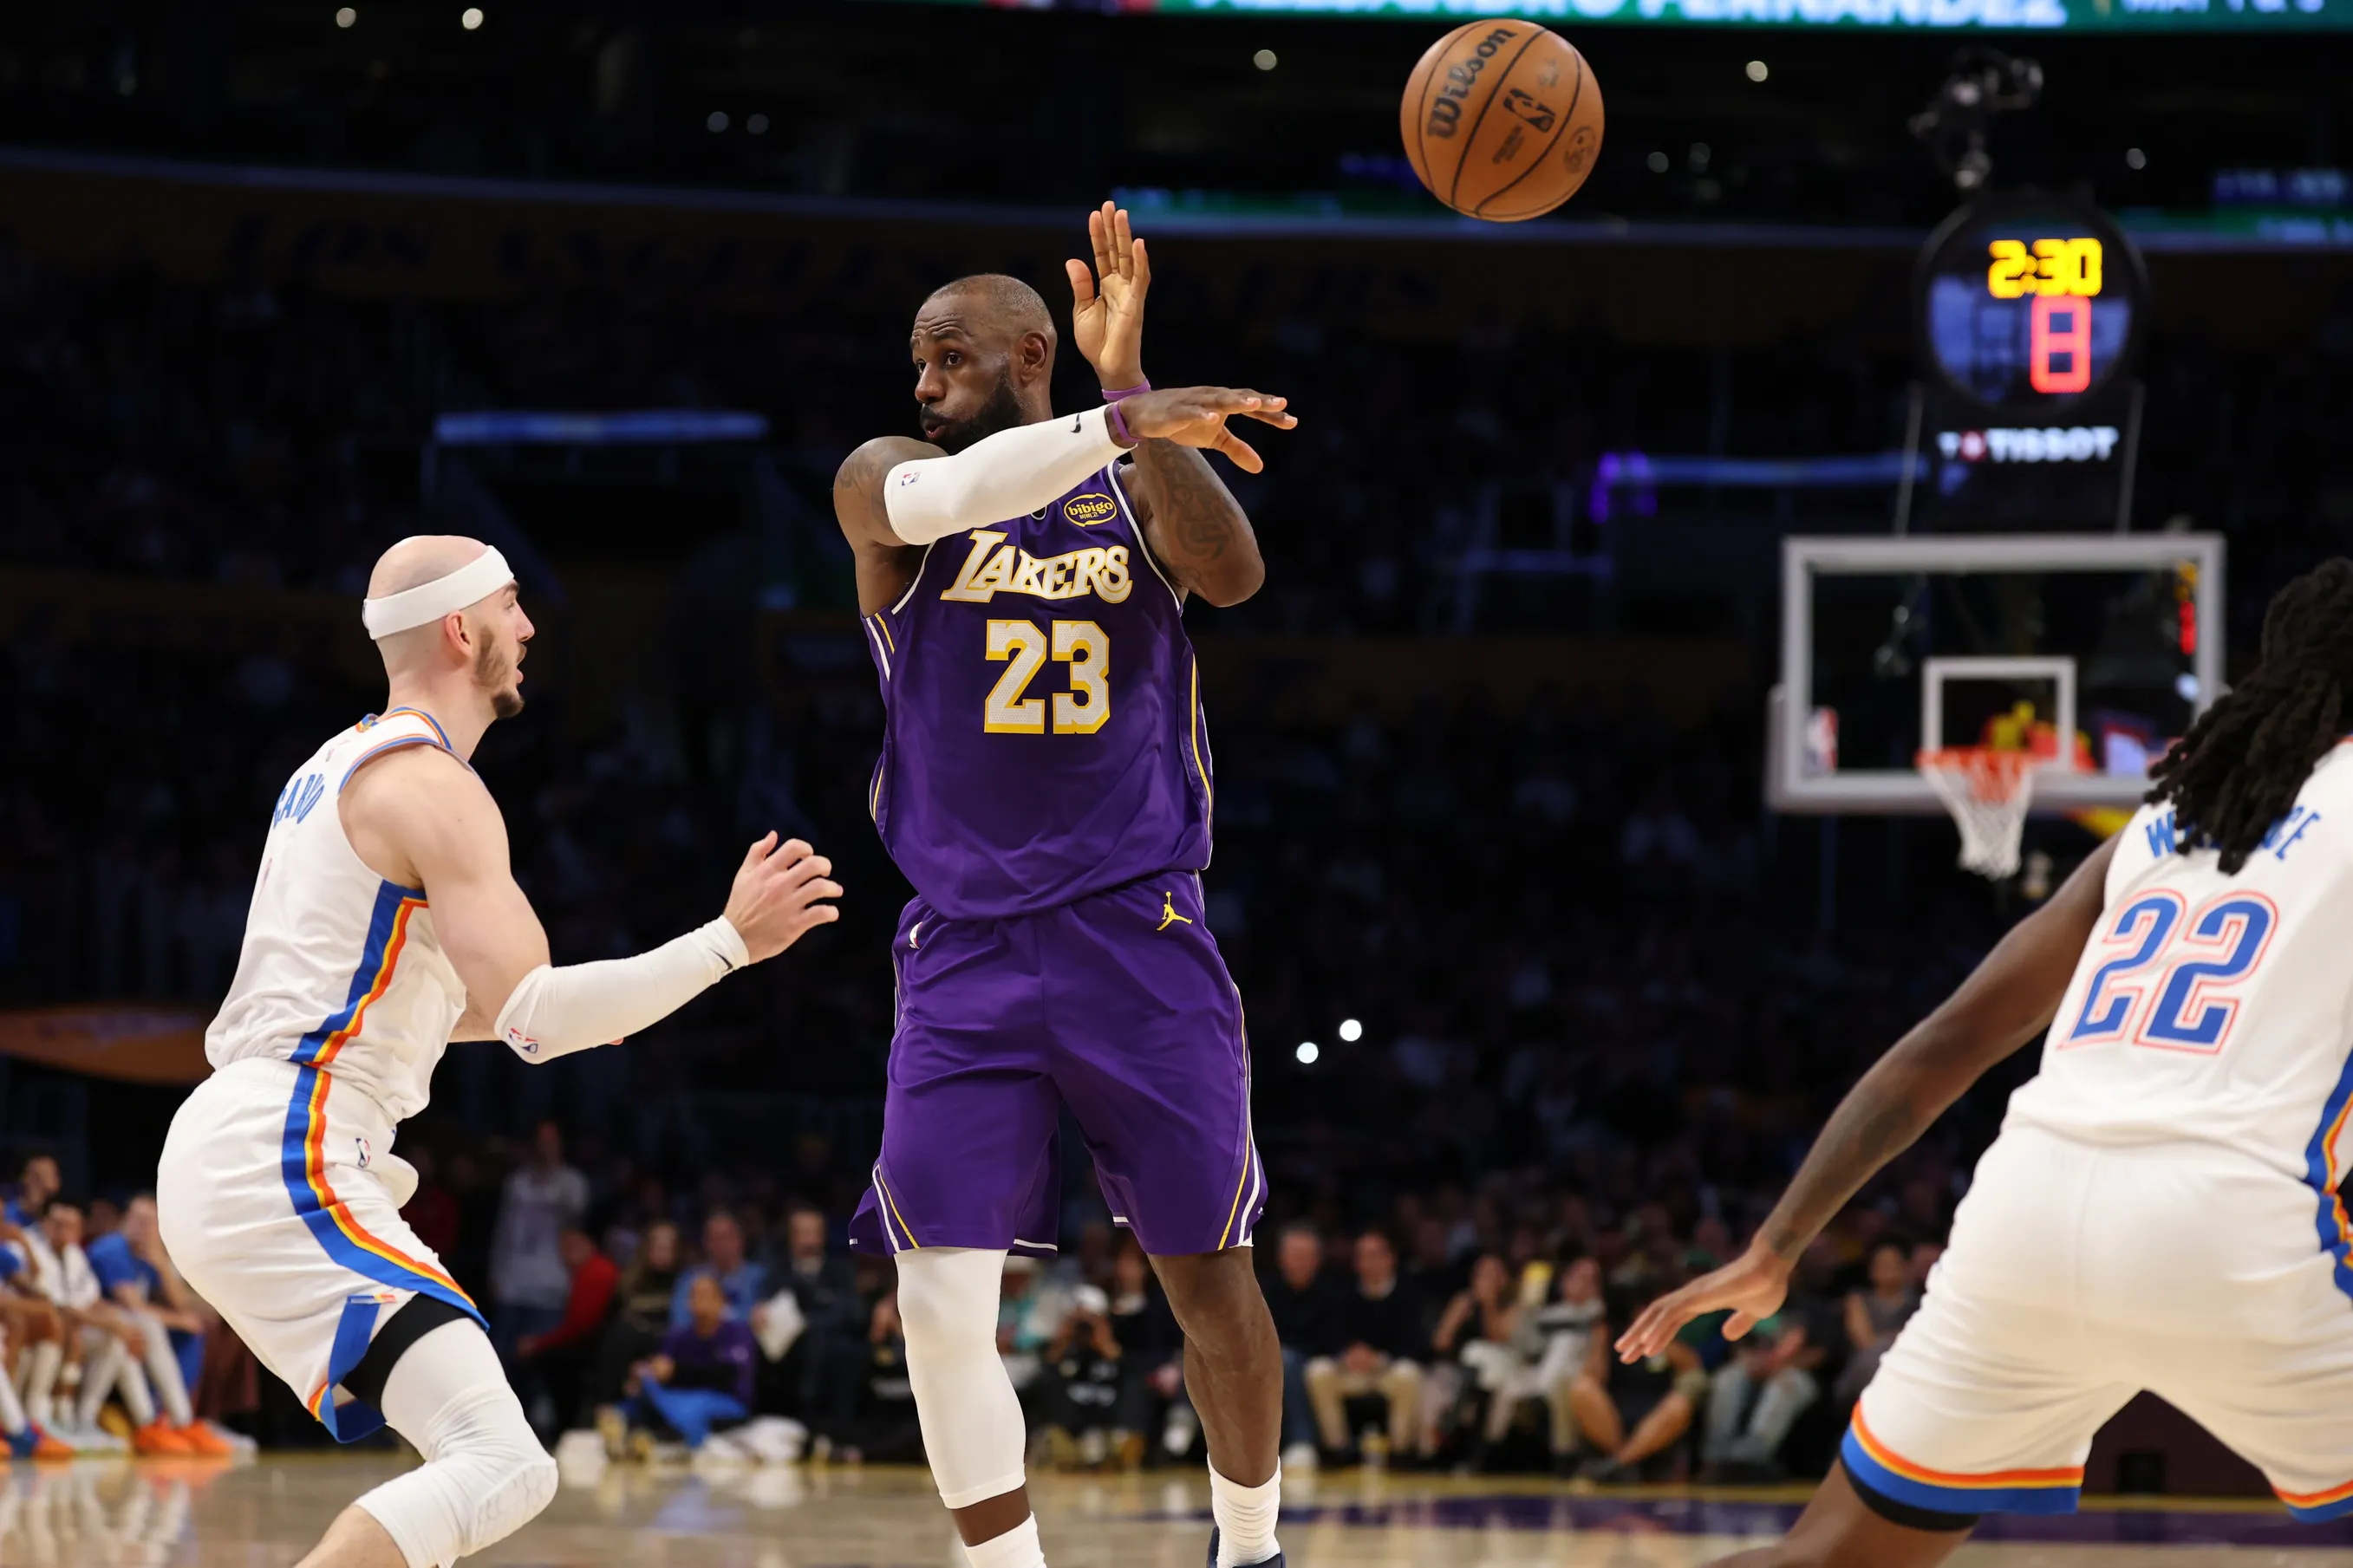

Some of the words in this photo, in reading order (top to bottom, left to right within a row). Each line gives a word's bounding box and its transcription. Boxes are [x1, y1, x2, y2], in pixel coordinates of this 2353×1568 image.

[1427, 28, 1518, 140] Wilson
[1988, 237, 2102, 298] 2:30
[2030, 295, 2091, 394] 8
[1067, 501, 1114, 516] bibigo
[940, 530, 1133, 604] LAKERS
[983, 618, 1111, 735] 23
[2056, 887, 2280, 1056] 22
